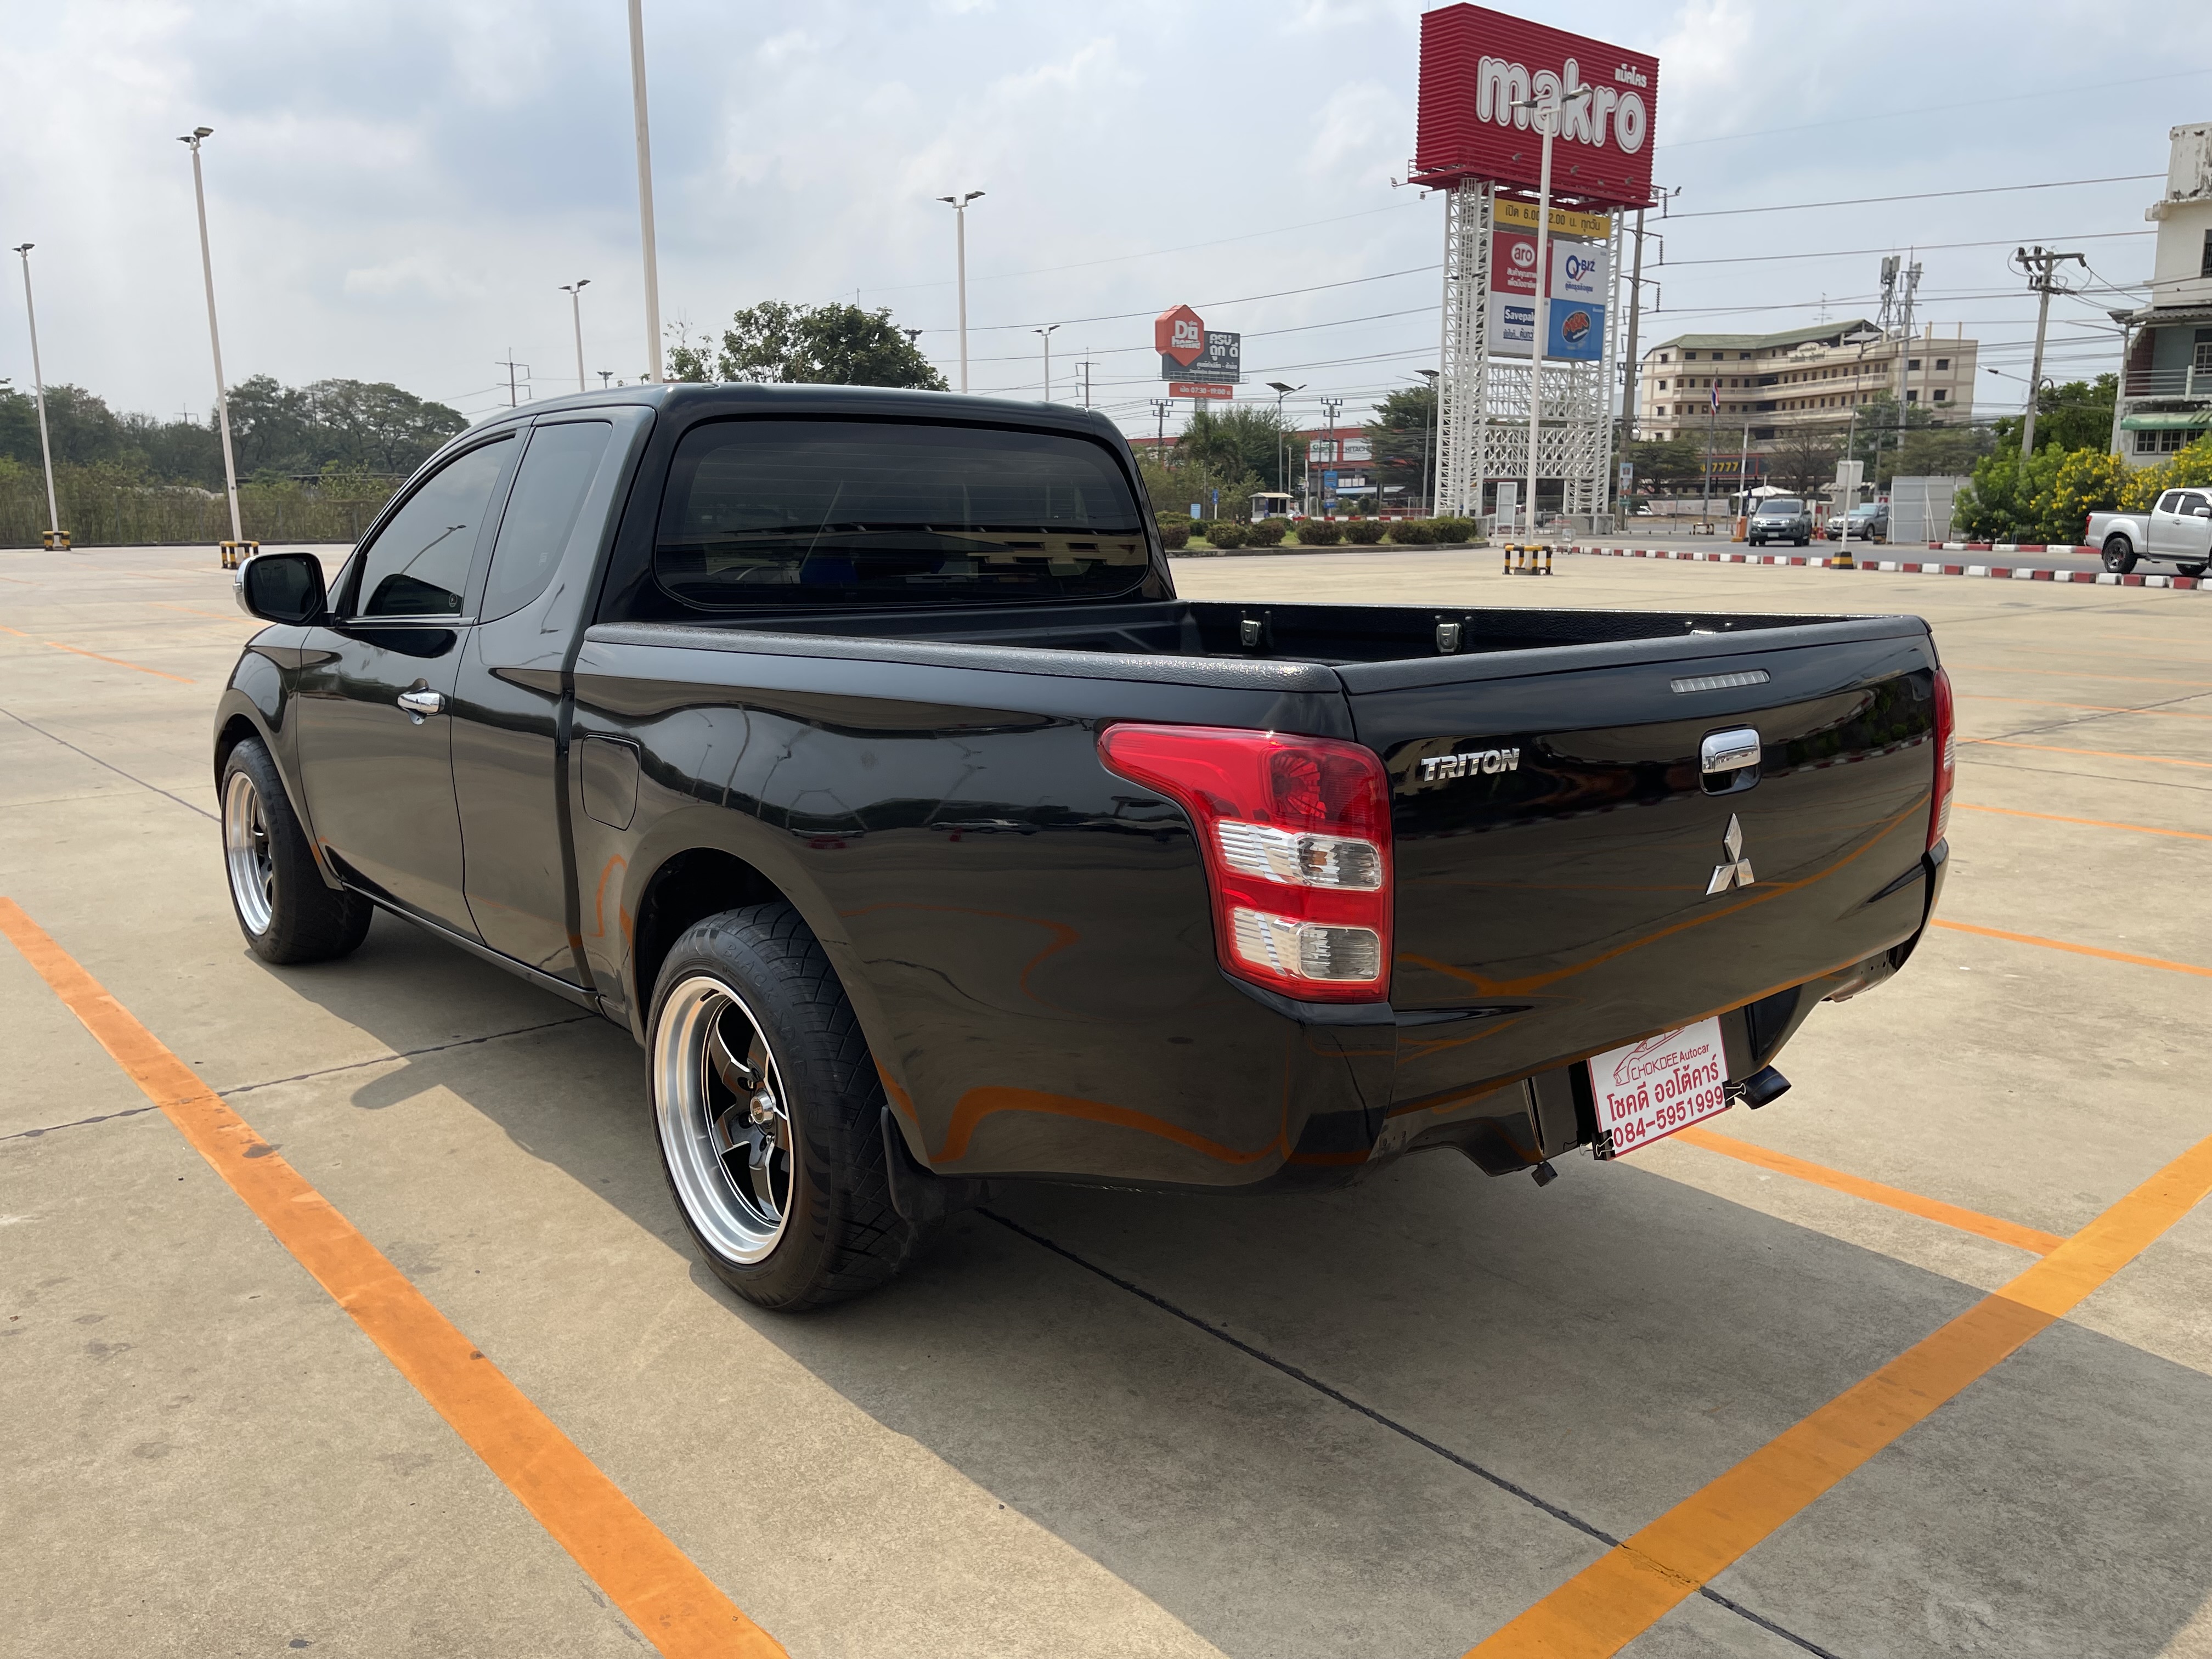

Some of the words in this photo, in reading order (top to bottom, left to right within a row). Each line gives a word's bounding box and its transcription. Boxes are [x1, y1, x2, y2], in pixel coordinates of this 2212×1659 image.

[1615, 63, 1647, 88] แม็คโคร
[1476, 55, 1646, 154] makro
[1505, 205, 1519, 217] เปิด
[1570, 218, 1577, 227] น.
[1581, 219, 1600, 232] ทุกวัน
[1514, 247, 1532, 262] aro
[1171, 335, 1201, 349] home
[1209, 334, 1232, 346] ครบ
[1209, 345, 1226, 361] ถูก
[1229, 342, 1239, 358] ดี
[1420, 748, 1520, 782] TRITON
[1630, 1052, 1679, 1081] CHOKDEE
[1679, 1043, 1709, 1063] Autocar
[1606, 1081, 1650, 1122] โชคดี
[1654, 1053, 1719, 1103] ออโต้คาร์
[1613, 1086, 1724, 1148] 084-5951999
